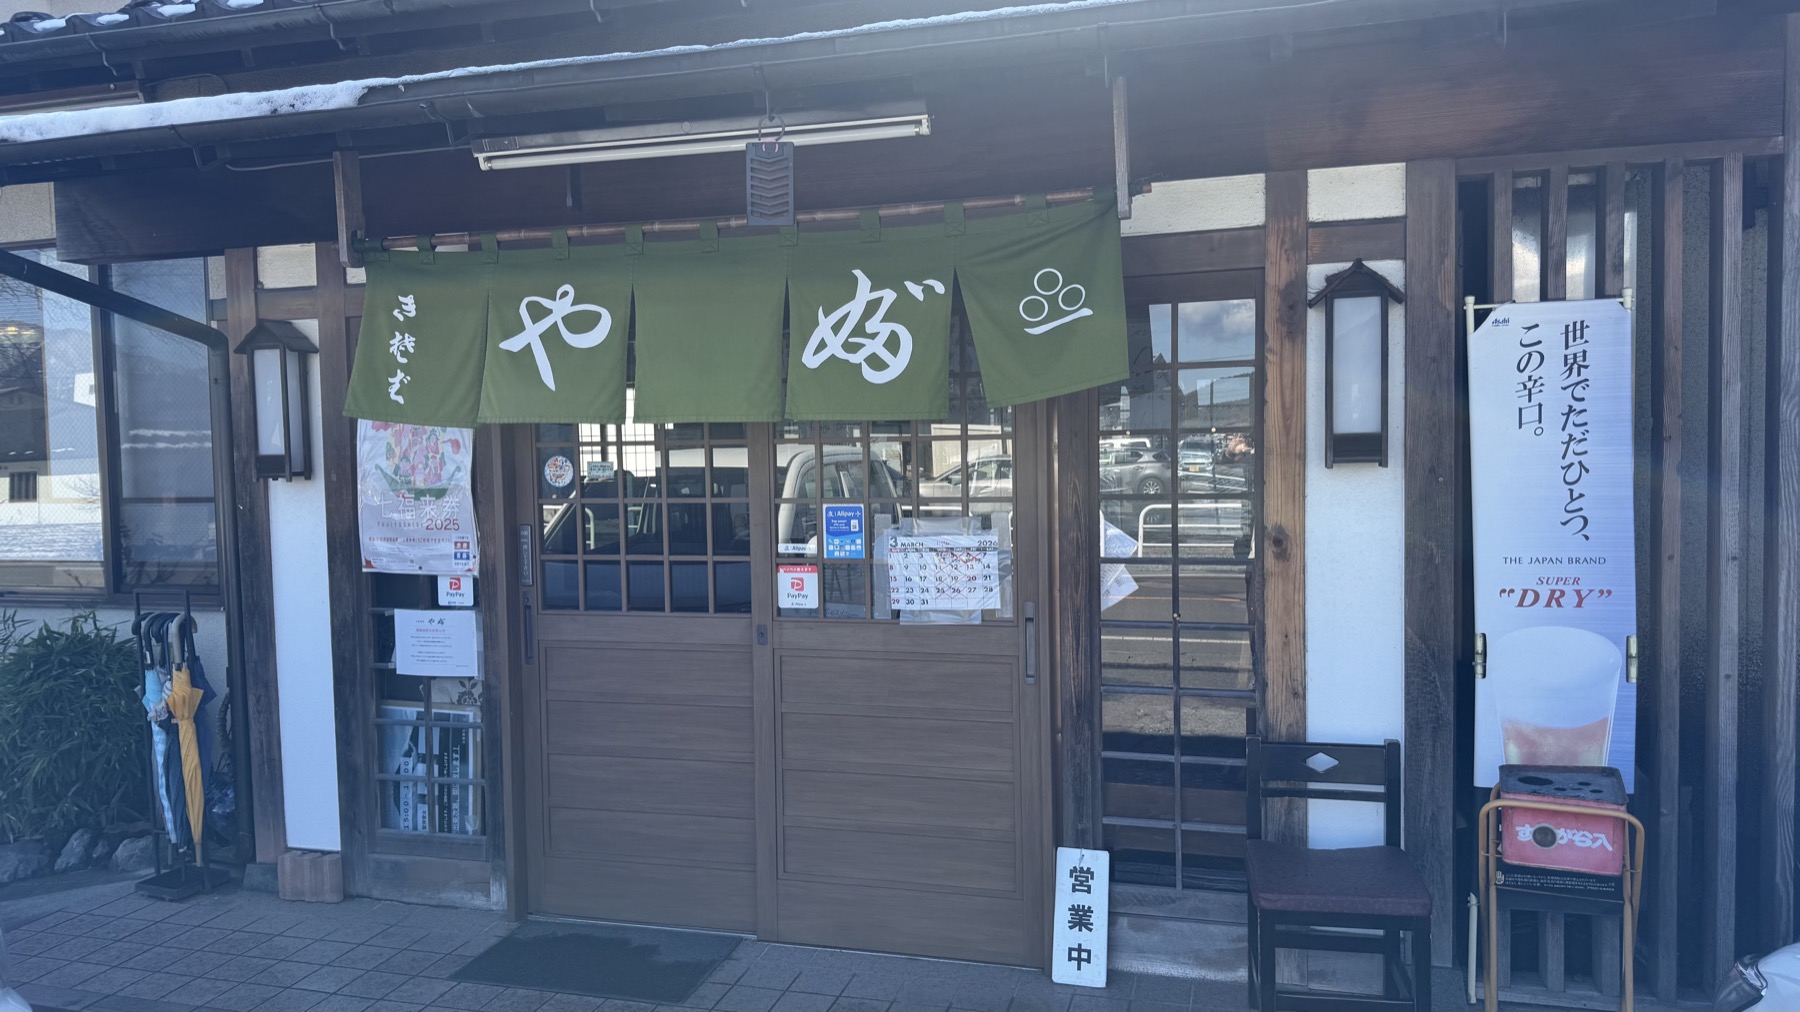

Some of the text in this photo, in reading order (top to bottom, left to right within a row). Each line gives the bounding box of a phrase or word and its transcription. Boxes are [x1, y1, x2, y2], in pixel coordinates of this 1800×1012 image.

[1514, 323, 1546, 437] この辛口。
[1559, 319, 1591, 541] 世界でただひとつ、
[425, 518, 460, 531] 2025
[889, 537, 899, 547] 3
[1502, 557, 1607, 565] THE JAPAN BRAND
[1536, 576, 1581, 586] SUPER
[1515, 823, 1613, 852] すがら入
[1067, 865, 1095, 972] 営業中
